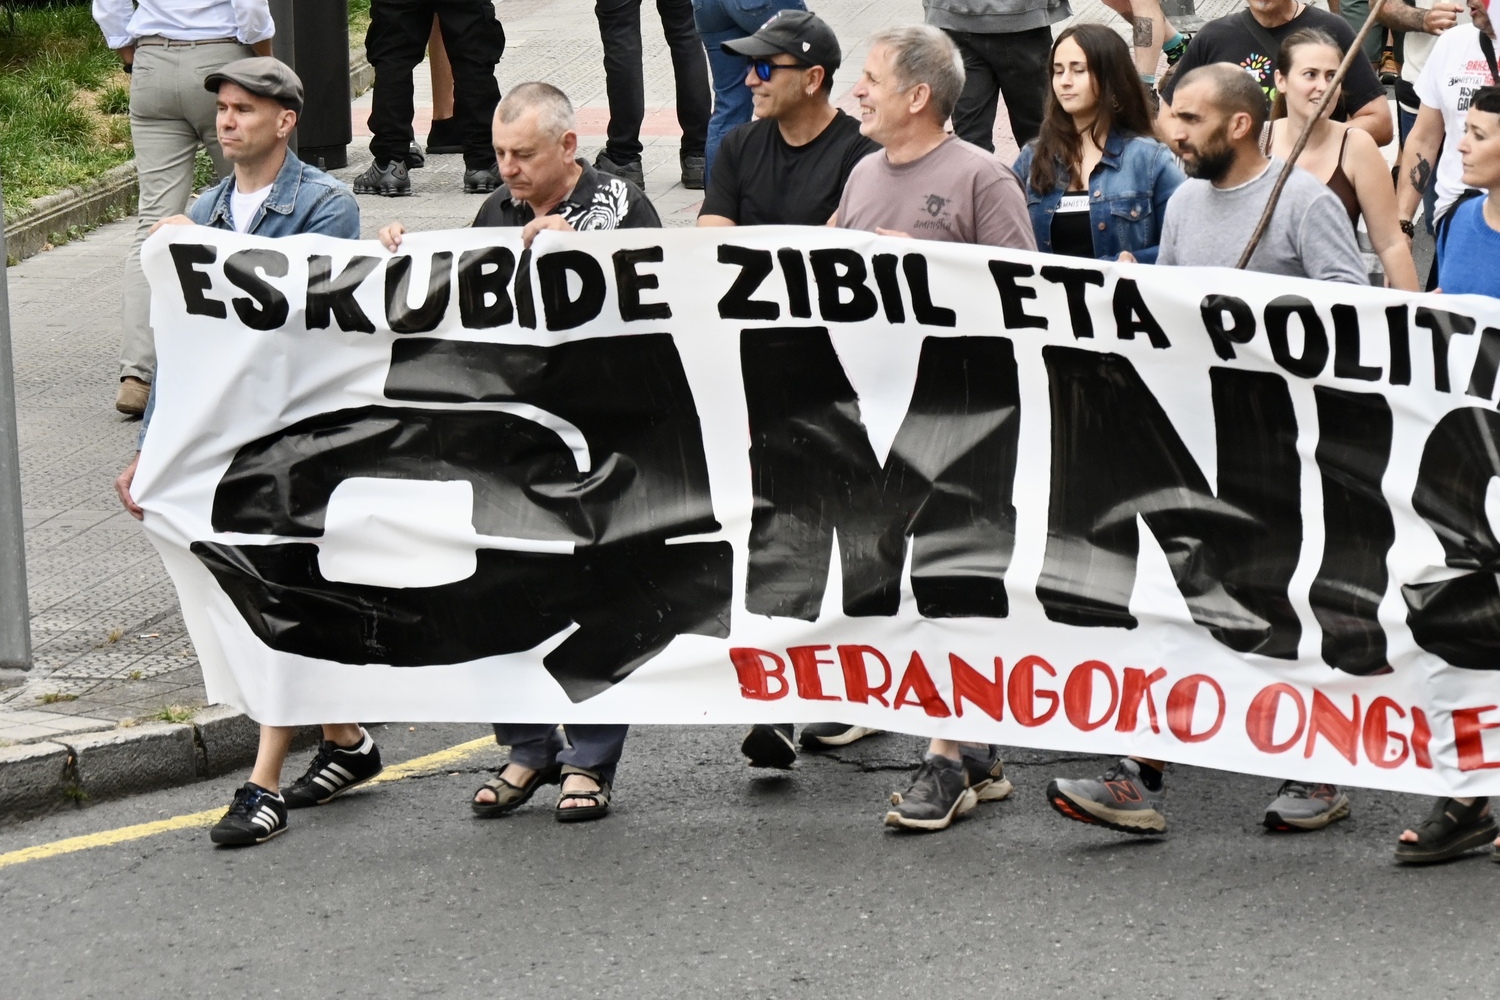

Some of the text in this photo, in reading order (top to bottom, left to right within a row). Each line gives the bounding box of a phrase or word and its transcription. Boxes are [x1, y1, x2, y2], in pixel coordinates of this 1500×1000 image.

[168, 243, 673, 334] ESKUBIDE
[717, 244, 956, 327] ZIBIL
[988, 259, 1171, 349] ETA
[729, 643, 1226, 746] BERANGOKO
